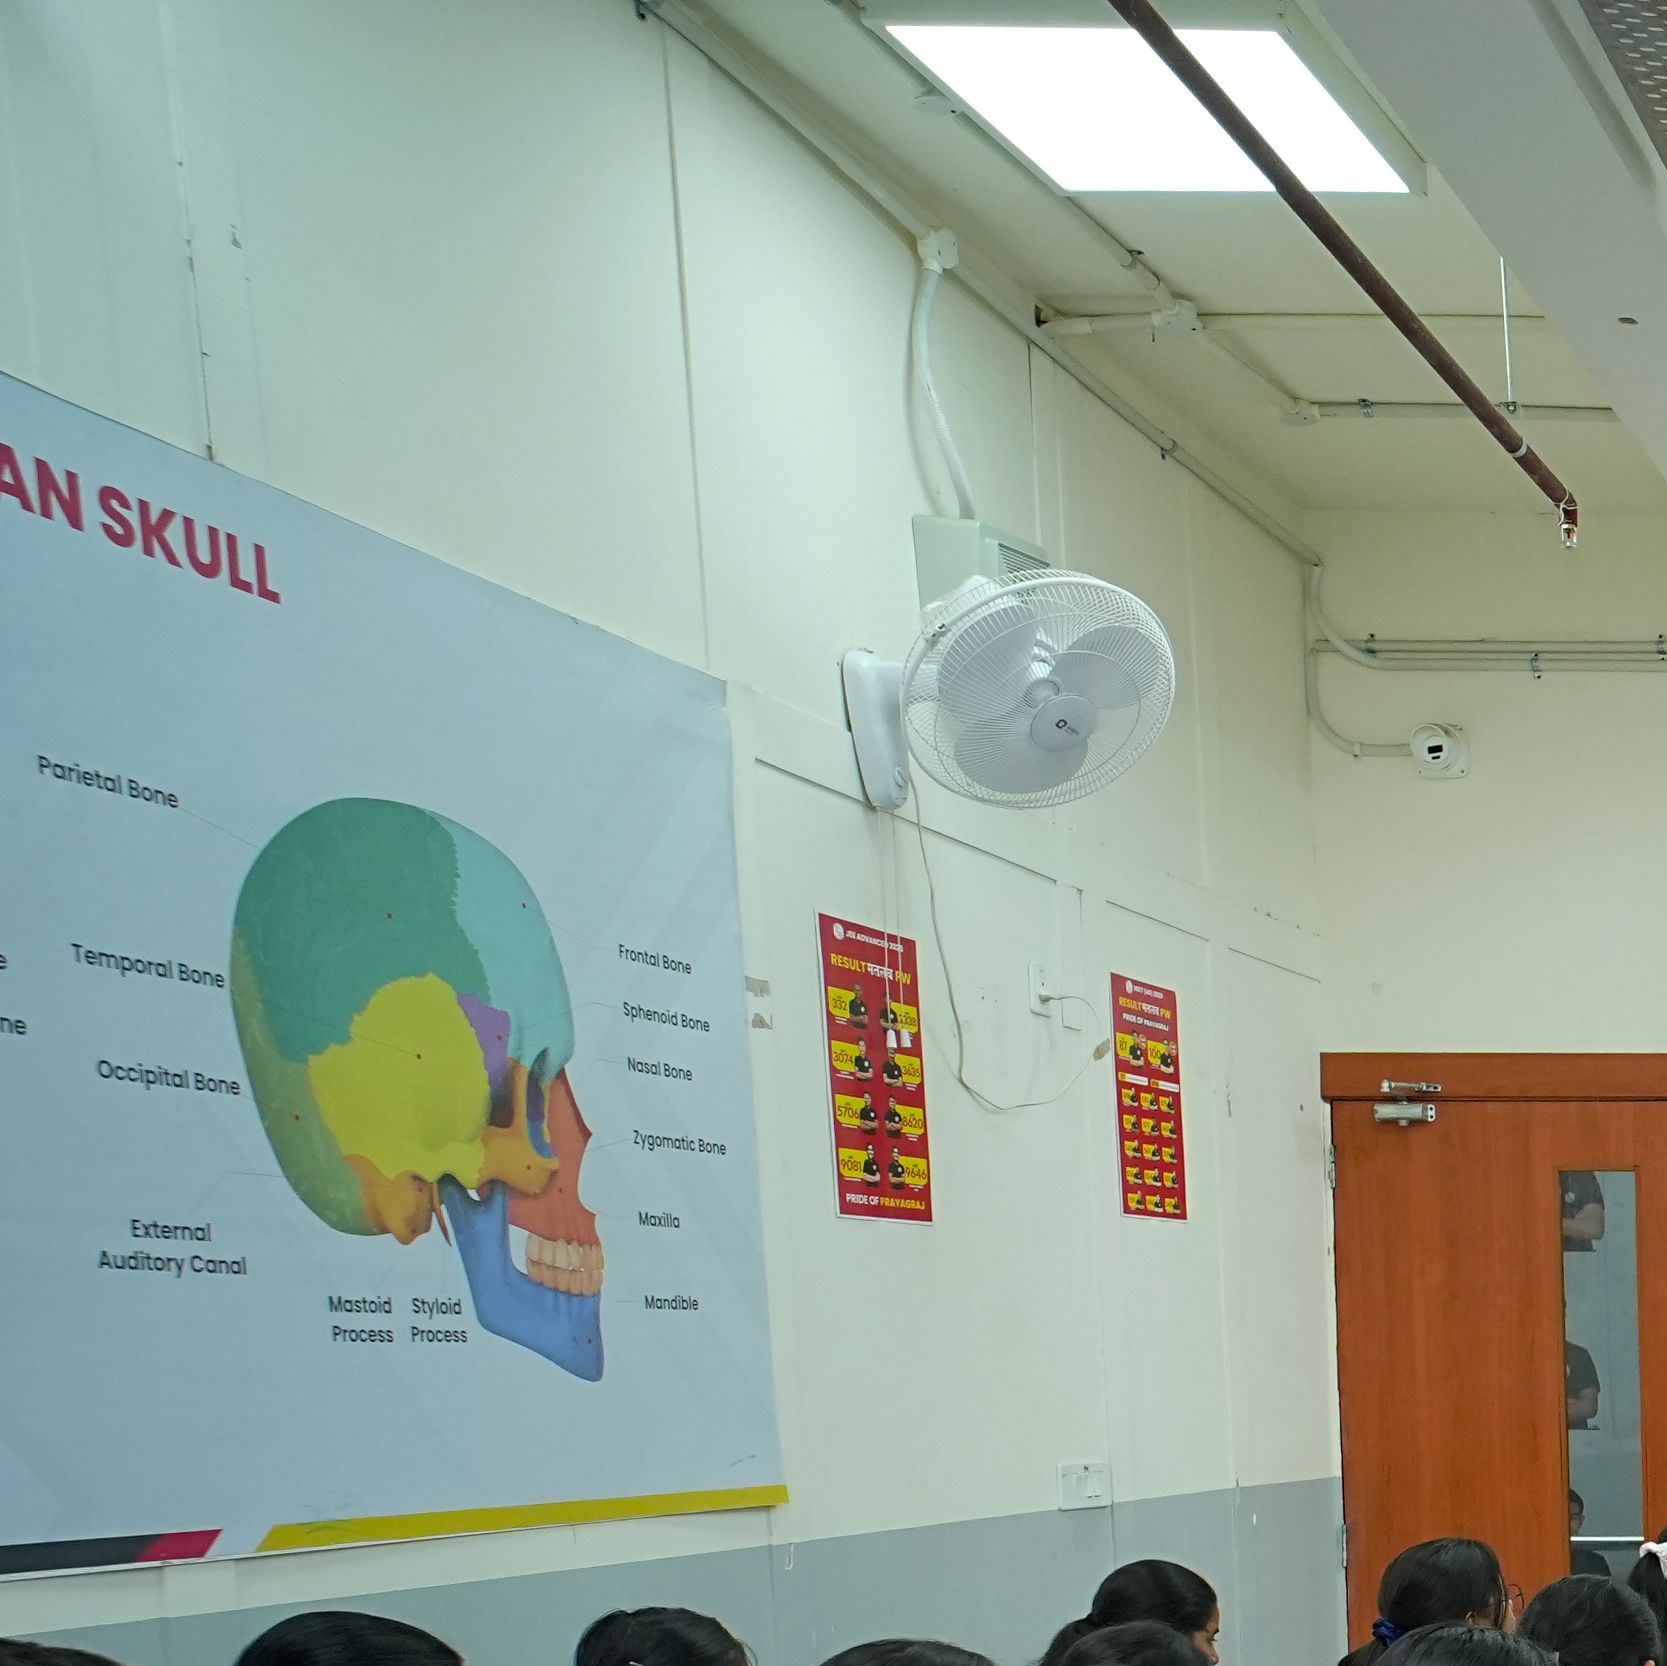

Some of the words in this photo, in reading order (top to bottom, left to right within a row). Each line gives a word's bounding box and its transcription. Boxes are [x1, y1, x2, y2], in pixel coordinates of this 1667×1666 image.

[0, 442, 85, 533] AN
[98, 485, 282, 605] SKULL
[37, 754, 122, 796] Parietal
[126, 778, 180, 810] Bone
[71, 943, 174, 980] Temporal
[177, 962, 226, 989] Bone
[618, 944, 660, 968] Frontal
[662, 954, 692, 975] Bone
[830, 952, 867, 974] RESULT
[894, 970, 912, 986] PW
[1118, 996, 1142, 1011] RESULT
[0, 1015, 28, 1036] ne
[623, 1001, 679, 1026] Sphenoid
[681, 1013, 711, 1033] Bone
[627, 1055, 662, 1077] Nasal
[663, 1062, 693, 1082] Bone
[832, 1050, 854, 1066] 3074
[97, 1059, 190, 1091] Occipital
[193, 1072, 241, 1096] Bone
[837, 1104, 860, 1120] 5706
[632, 1129, 696, 1152] Zygomatic
[698, 1138, 727, 1156] Bone
[845, 1192, 869, 1205] PRIDE
[130, 1218, 212, 1243] External
[638, 1210, 681, 1230] Maxilla
[98, 1250, 186, 1279] Auditory
[190, 1254, 248, 1276] Canal
[328, 1295, 393, 1315] Mastoid
[411, 1297, 463, 1320] Styloid
[644, 1294, 699, 1312] Mandible
[331, 1325, 395, 1343] Process
[409, 1325, 468, 1343] Process
